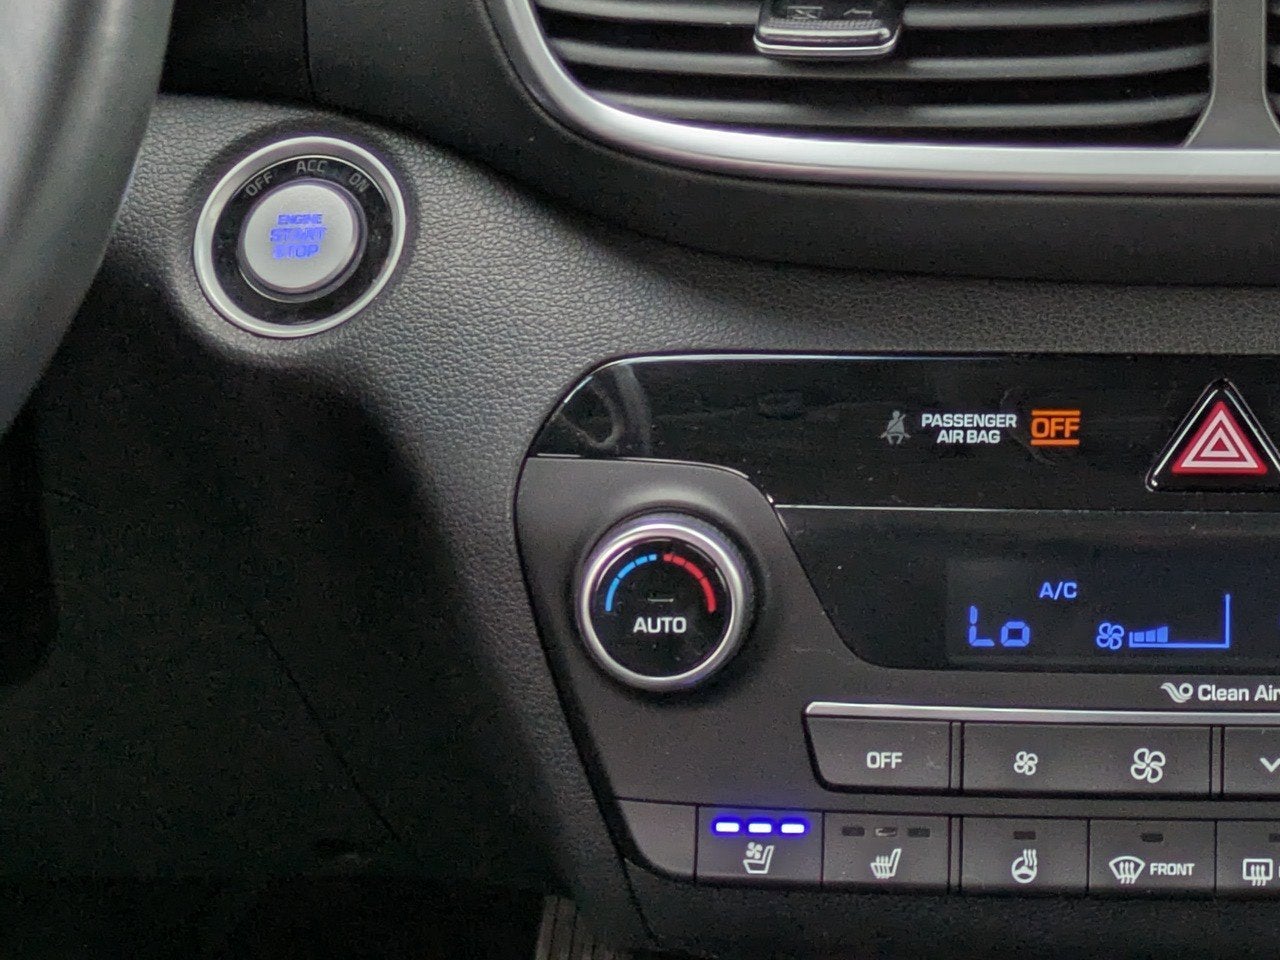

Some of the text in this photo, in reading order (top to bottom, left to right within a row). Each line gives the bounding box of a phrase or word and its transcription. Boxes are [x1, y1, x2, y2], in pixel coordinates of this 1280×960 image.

[296, 160, 328, 175] ACC
[245, 173, 273, 197] OFF
[349, 173, 371, 193] ON
[277, 213, 324, 226] ENGINE
[270, 226, 326, 243] START
[272, 243, 320, 260] STOP
[921, 413, 1017, 428] PASSENGER
[1031, 417, 1080, 439] OFF
[936, 429, 1001, 444] AIR BAG
[1039, 581, 1078, 600] A/C
[633, 616, 687, 634] AUTO
[1197, 684, 1250, 702] Clean
[866, 751, 903, 769] OFF
[1149, 862, 1195, 876] FRONT
